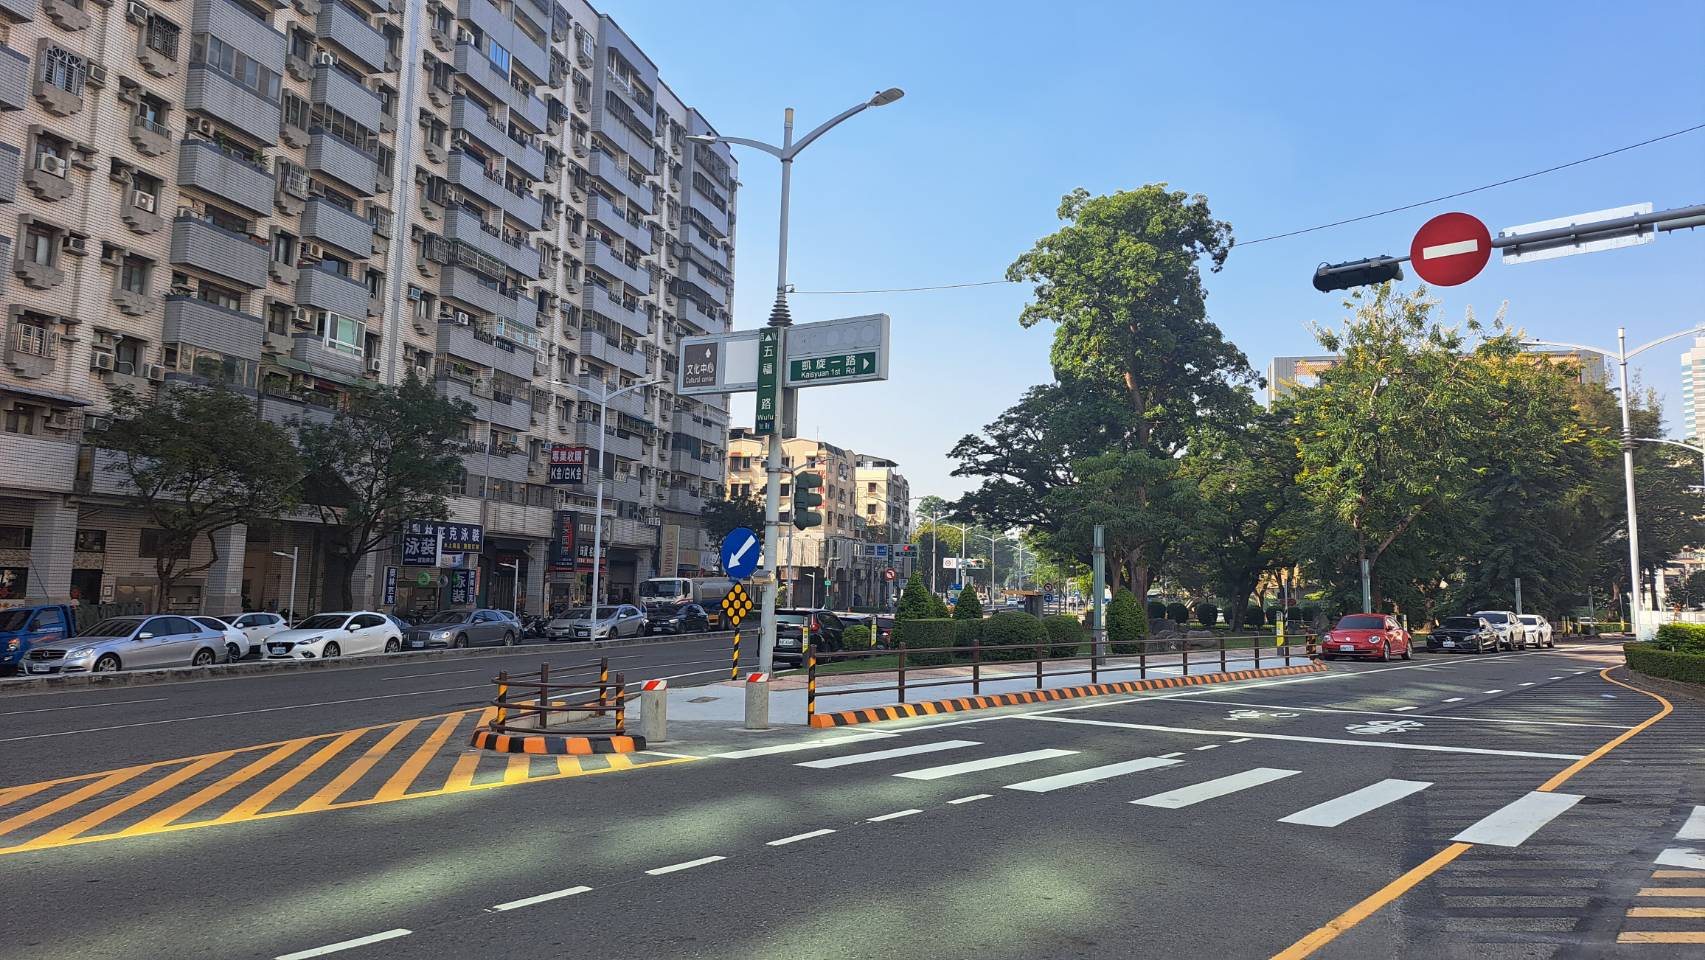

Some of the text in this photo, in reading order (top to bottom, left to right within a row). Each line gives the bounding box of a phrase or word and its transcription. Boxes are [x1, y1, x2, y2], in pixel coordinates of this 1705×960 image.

[687, 361, 714, 375] 文化中心
[801, 354, 856, 371] 凱旋一路
[761, 344, 774, 410] 五福一路
[801, 369, 830, 379] Kaisyuan
[831, 367, 841, 376] 1st
[552, 450, 582, 463] 專業收購
[405, 536, 436, 555] 泳裝
